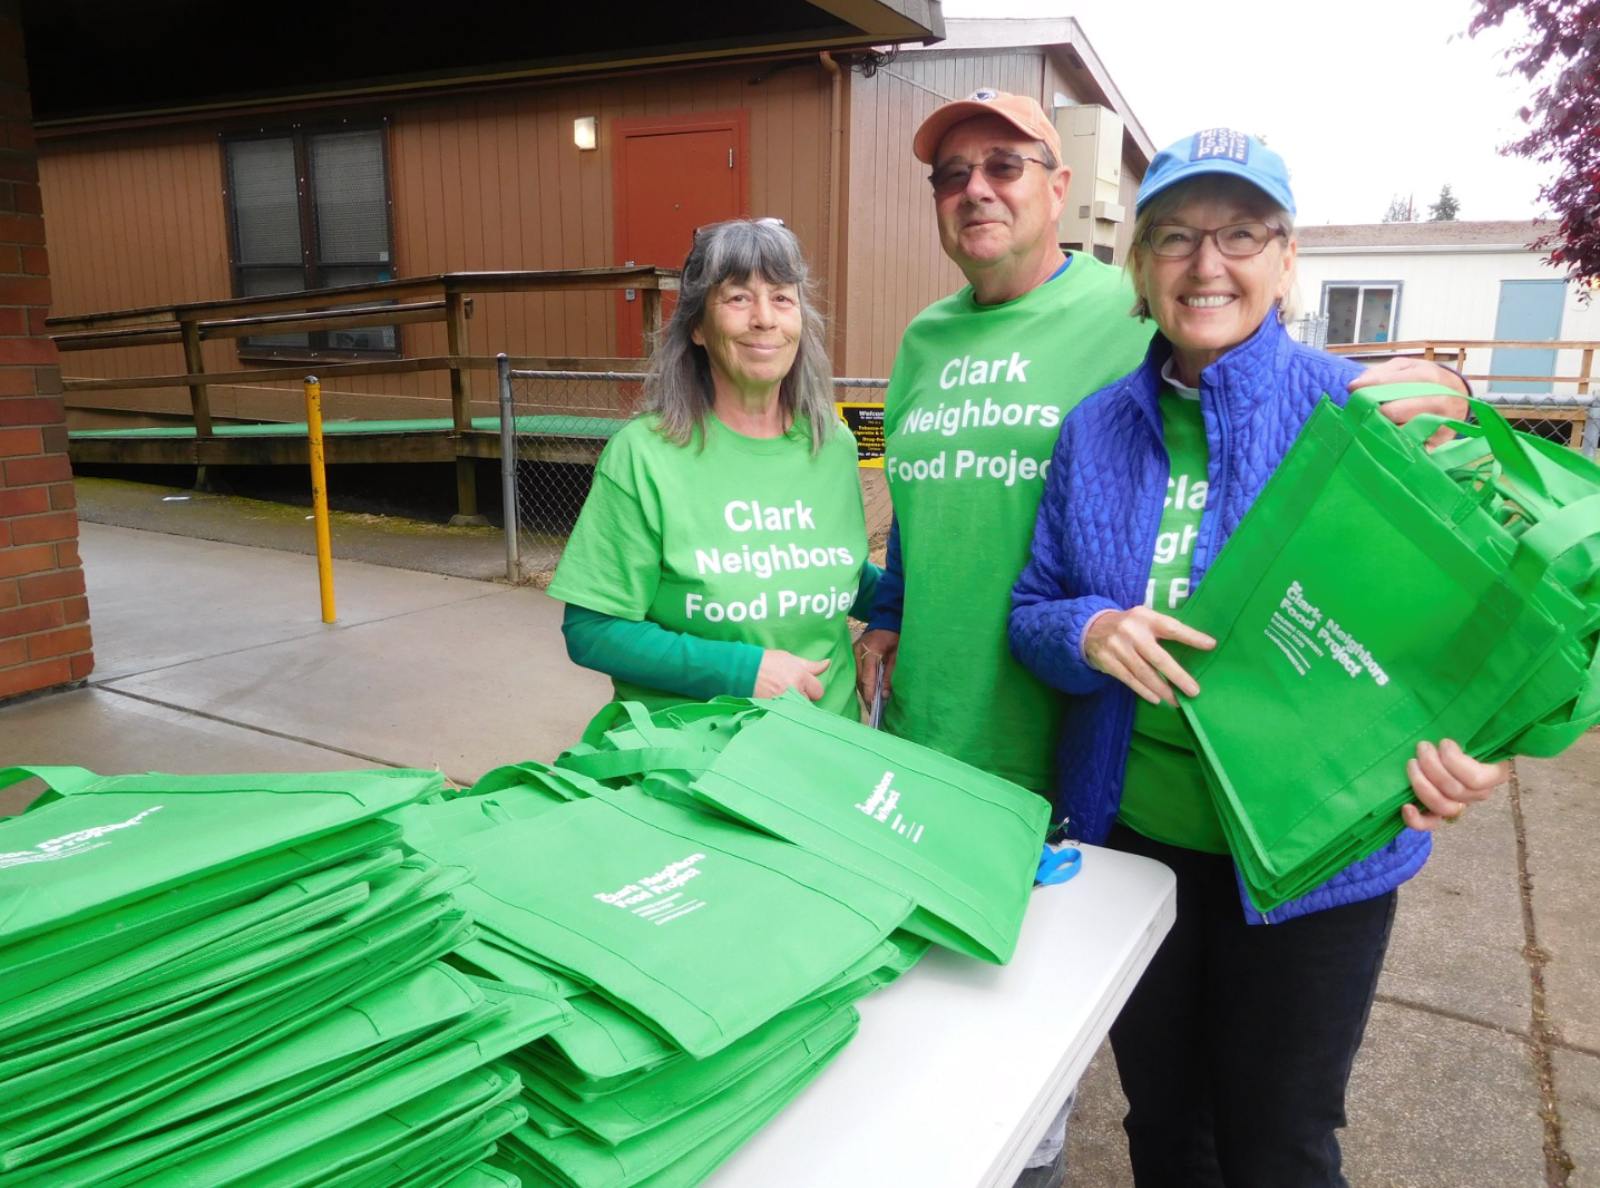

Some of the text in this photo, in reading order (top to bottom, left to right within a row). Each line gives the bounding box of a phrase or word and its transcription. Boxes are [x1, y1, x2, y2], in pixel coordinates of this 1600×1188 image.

[1198, 146, 1233, 158] PPI
[939, 352, 1032, 390] Clark
[902, 398, 1060, 437] Neighbors
[887, 449, 1051, 487] Food Projec
[724, 499, 816, 532] Clark
[695, 543, 854, 579] Neighbors
[685, 586, 858, 622] Food Projec
[1280, 597, 1316, 631] Food
[1317, 627, 1362, 678] Project
[1286, 586, 1323, 622] Clark
[1325, 618, 1389, 686] Neighbors
